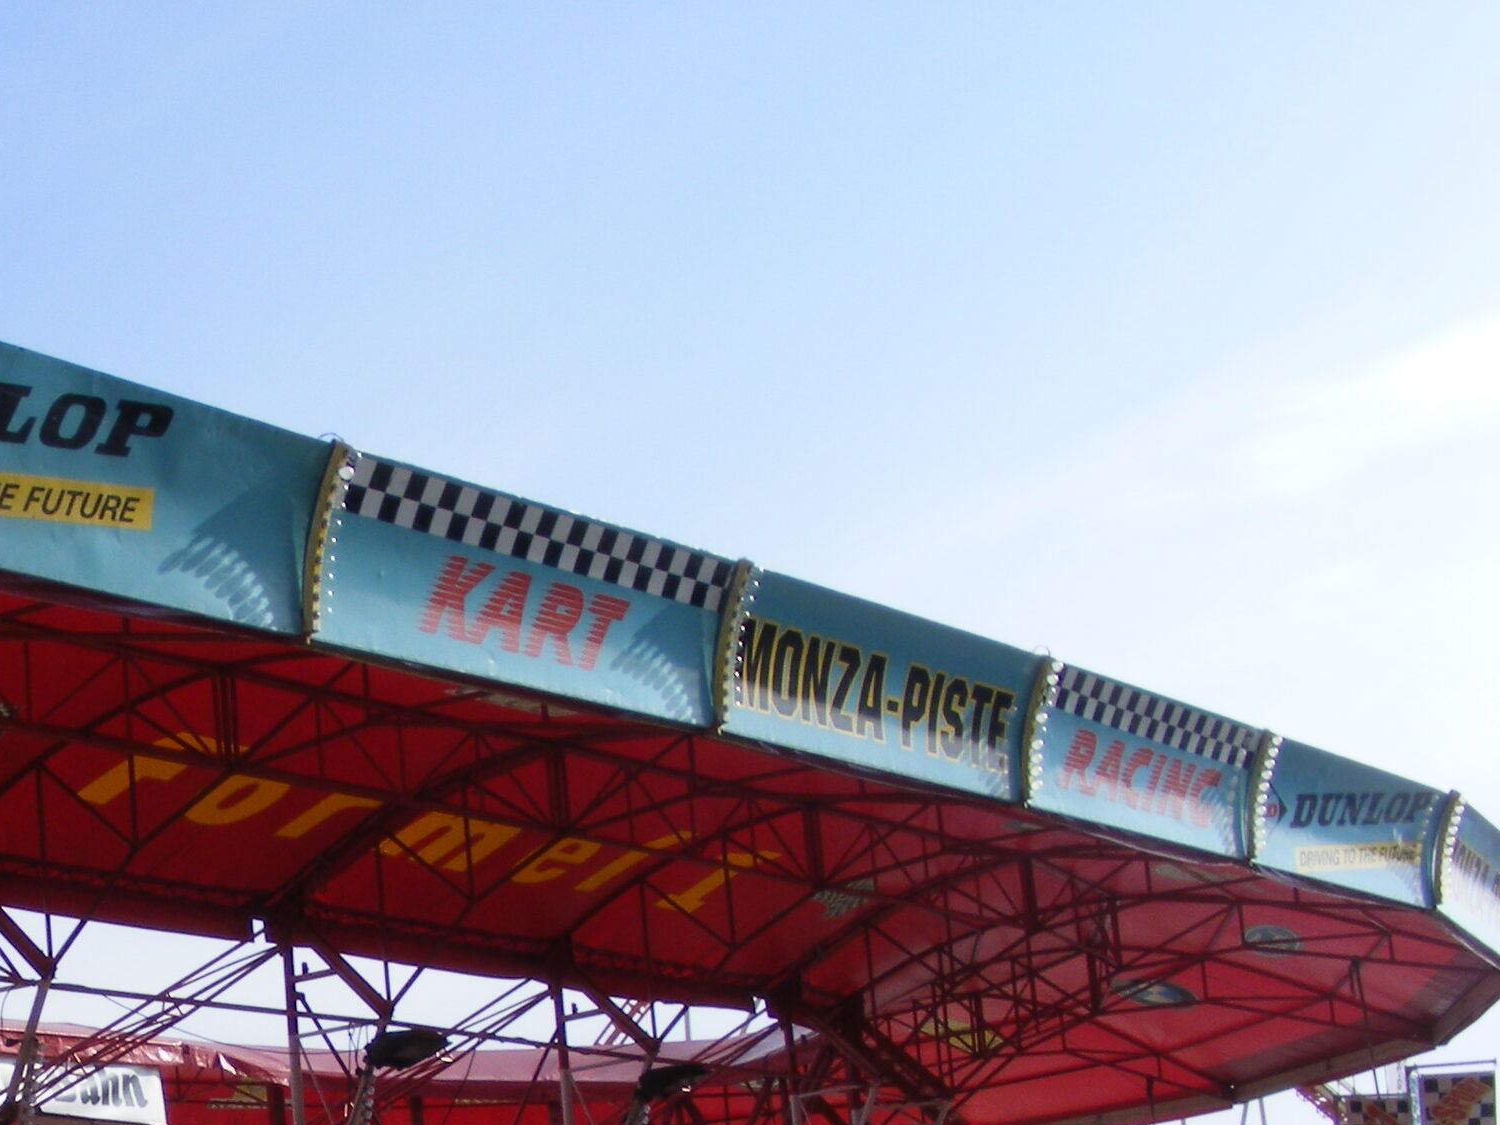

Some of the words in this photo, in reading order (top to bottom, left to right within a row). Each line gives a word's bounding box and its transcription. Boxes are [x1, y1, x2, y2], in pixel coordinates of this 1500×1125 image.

[23, 486, 140, 523] FUTURE
[418, 555, 631, 671] KART
[734, 615, 1016, 773] MONZA-PISTE
[1056, 728, 1222, 828] RACING
[1290, 791, 1435, 828] DUNLOP
